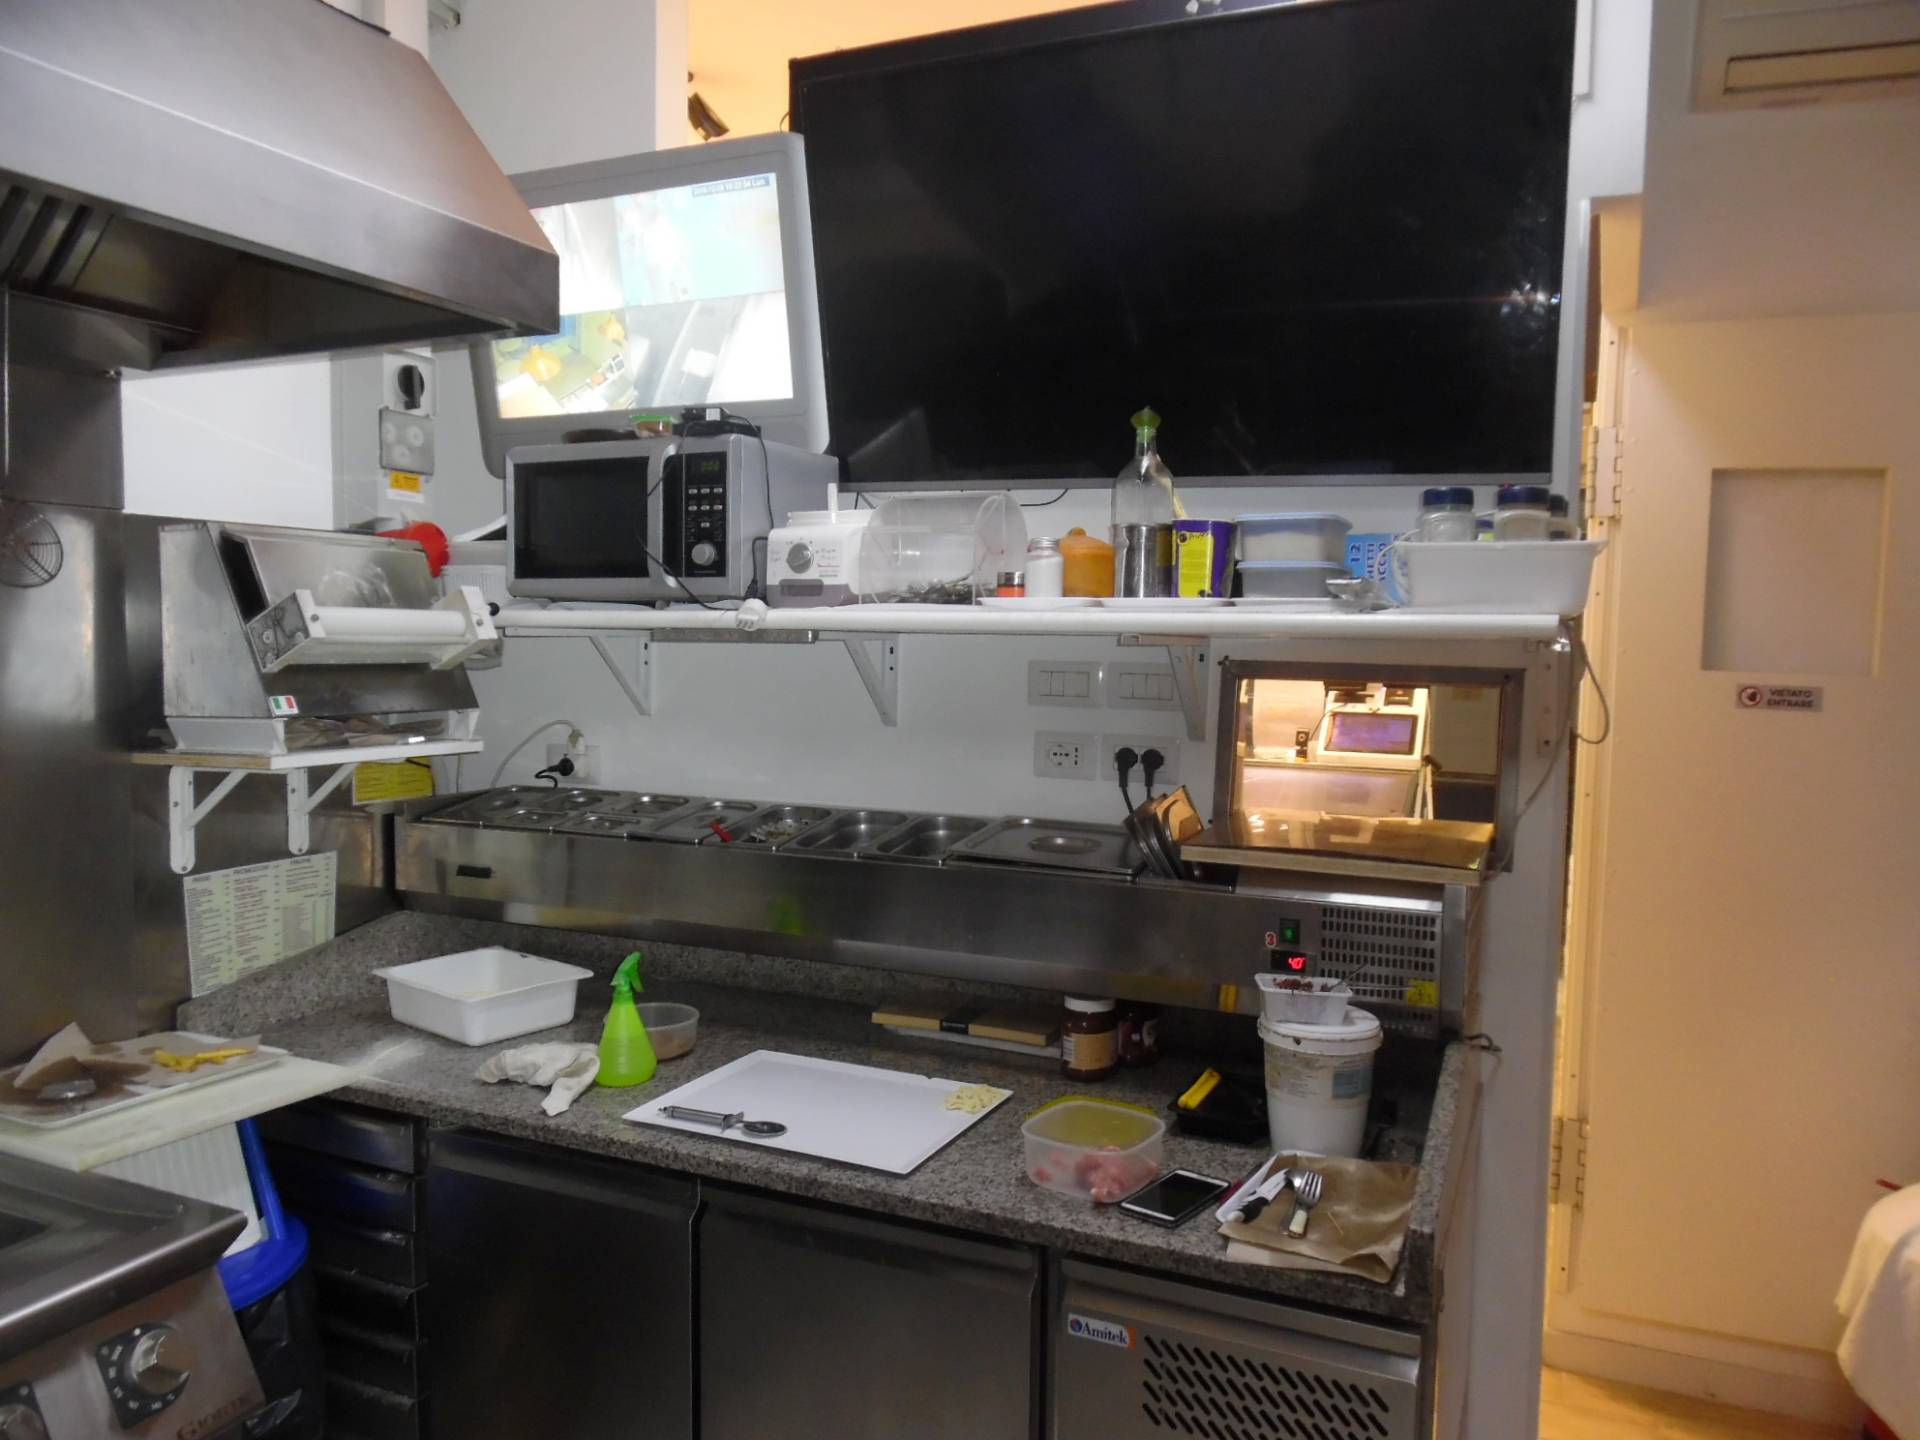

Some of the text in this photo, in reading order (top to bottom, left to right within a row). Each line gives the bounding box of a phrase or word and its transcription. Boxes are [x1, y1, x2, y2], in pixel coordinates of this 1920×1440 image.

[1768, 688, 1813, 698] VIETATO
[1767, 698, 1814, 708] ENTRARE
[1082, 1321, 1128, 1345] Amitek
